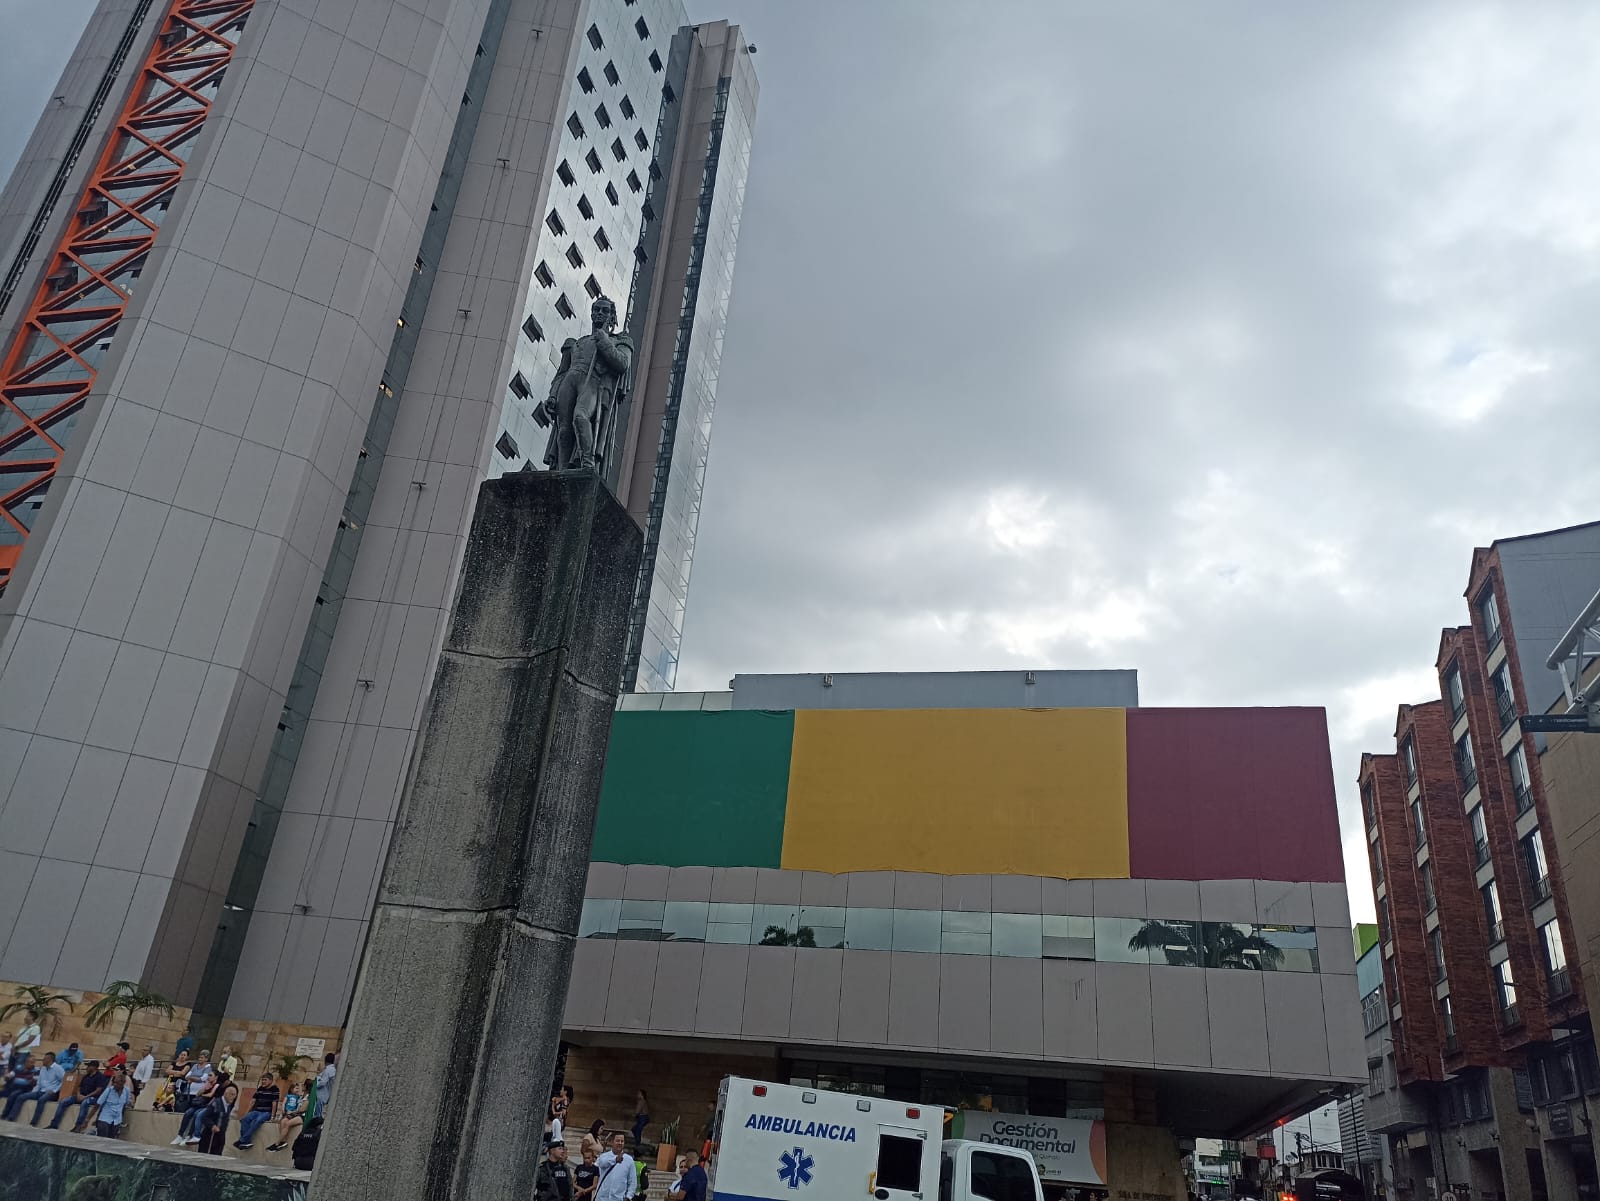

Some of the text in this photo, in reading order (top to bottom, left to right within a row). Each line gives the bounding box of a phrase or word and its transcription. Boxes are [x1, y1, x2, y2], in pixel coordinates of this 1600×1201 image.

[744, 1113, 856, 1142] AMBULANCIA
[992, 1120, 1058, 1139] Gestión
[979, 1132, 1076, 1153] Documental
